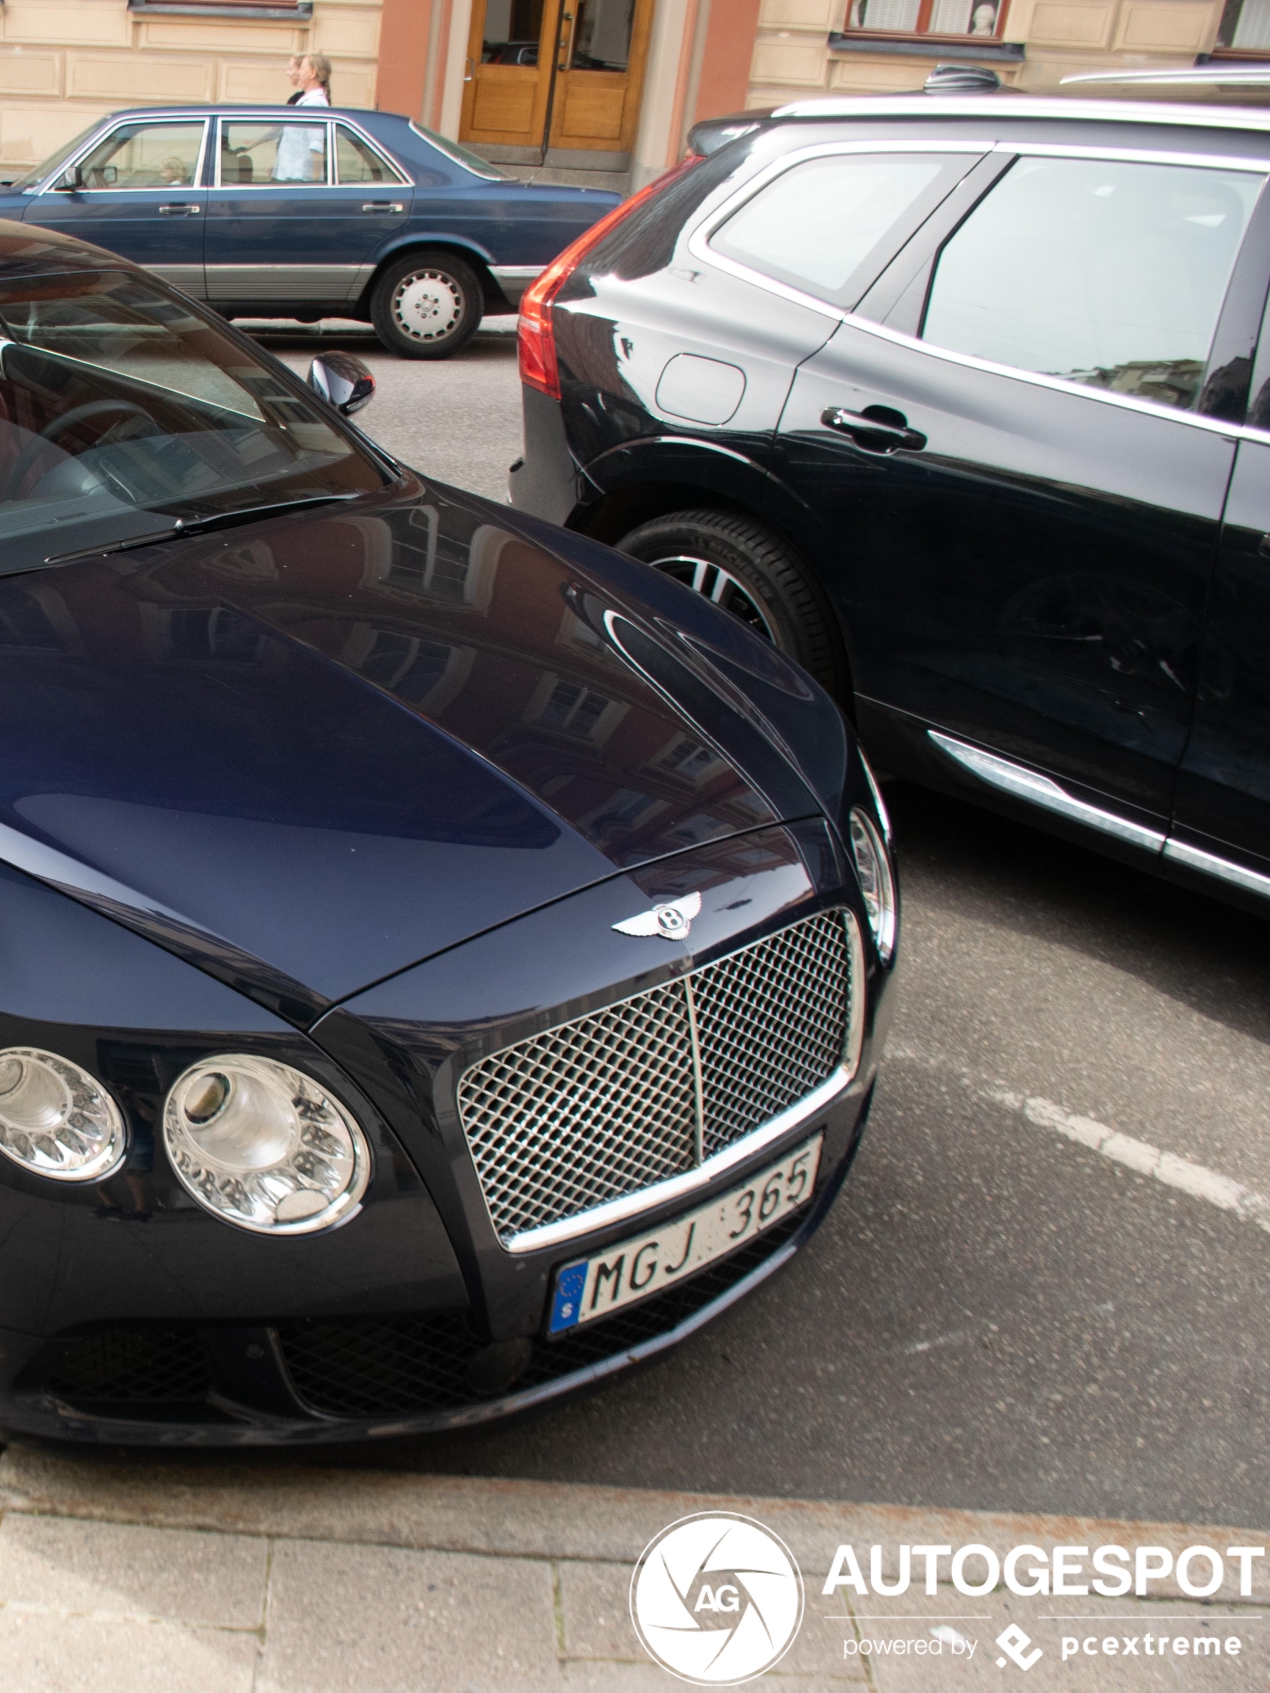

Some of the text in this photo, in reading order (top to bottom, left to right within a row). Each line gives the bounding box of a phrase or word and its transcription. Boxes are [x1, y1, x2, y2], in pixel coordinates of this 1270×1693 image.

[590, 1150, 812, 1312] MGJ 365
[560, 1303, 573, 1319] S
